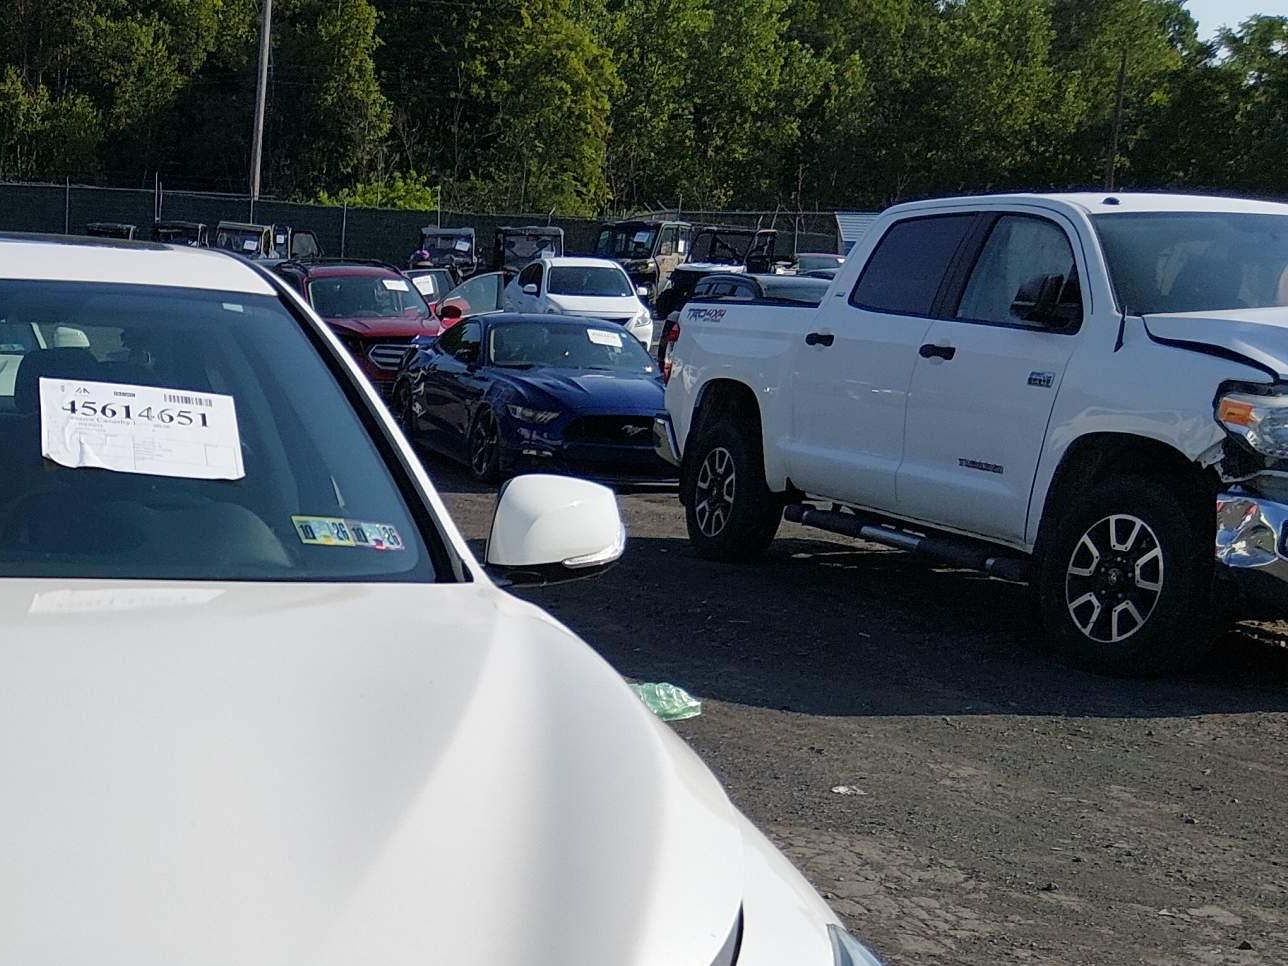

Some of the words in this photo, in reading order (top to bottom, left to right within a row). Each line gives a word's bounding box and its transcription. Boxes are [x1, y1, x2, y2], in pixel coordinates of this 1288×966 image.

[62, 399, 209, 428] 45614651
[300, 524, 317, 540] 10
[332, 522, 350, 541] 26
[382, 526, 401, 546] 26
